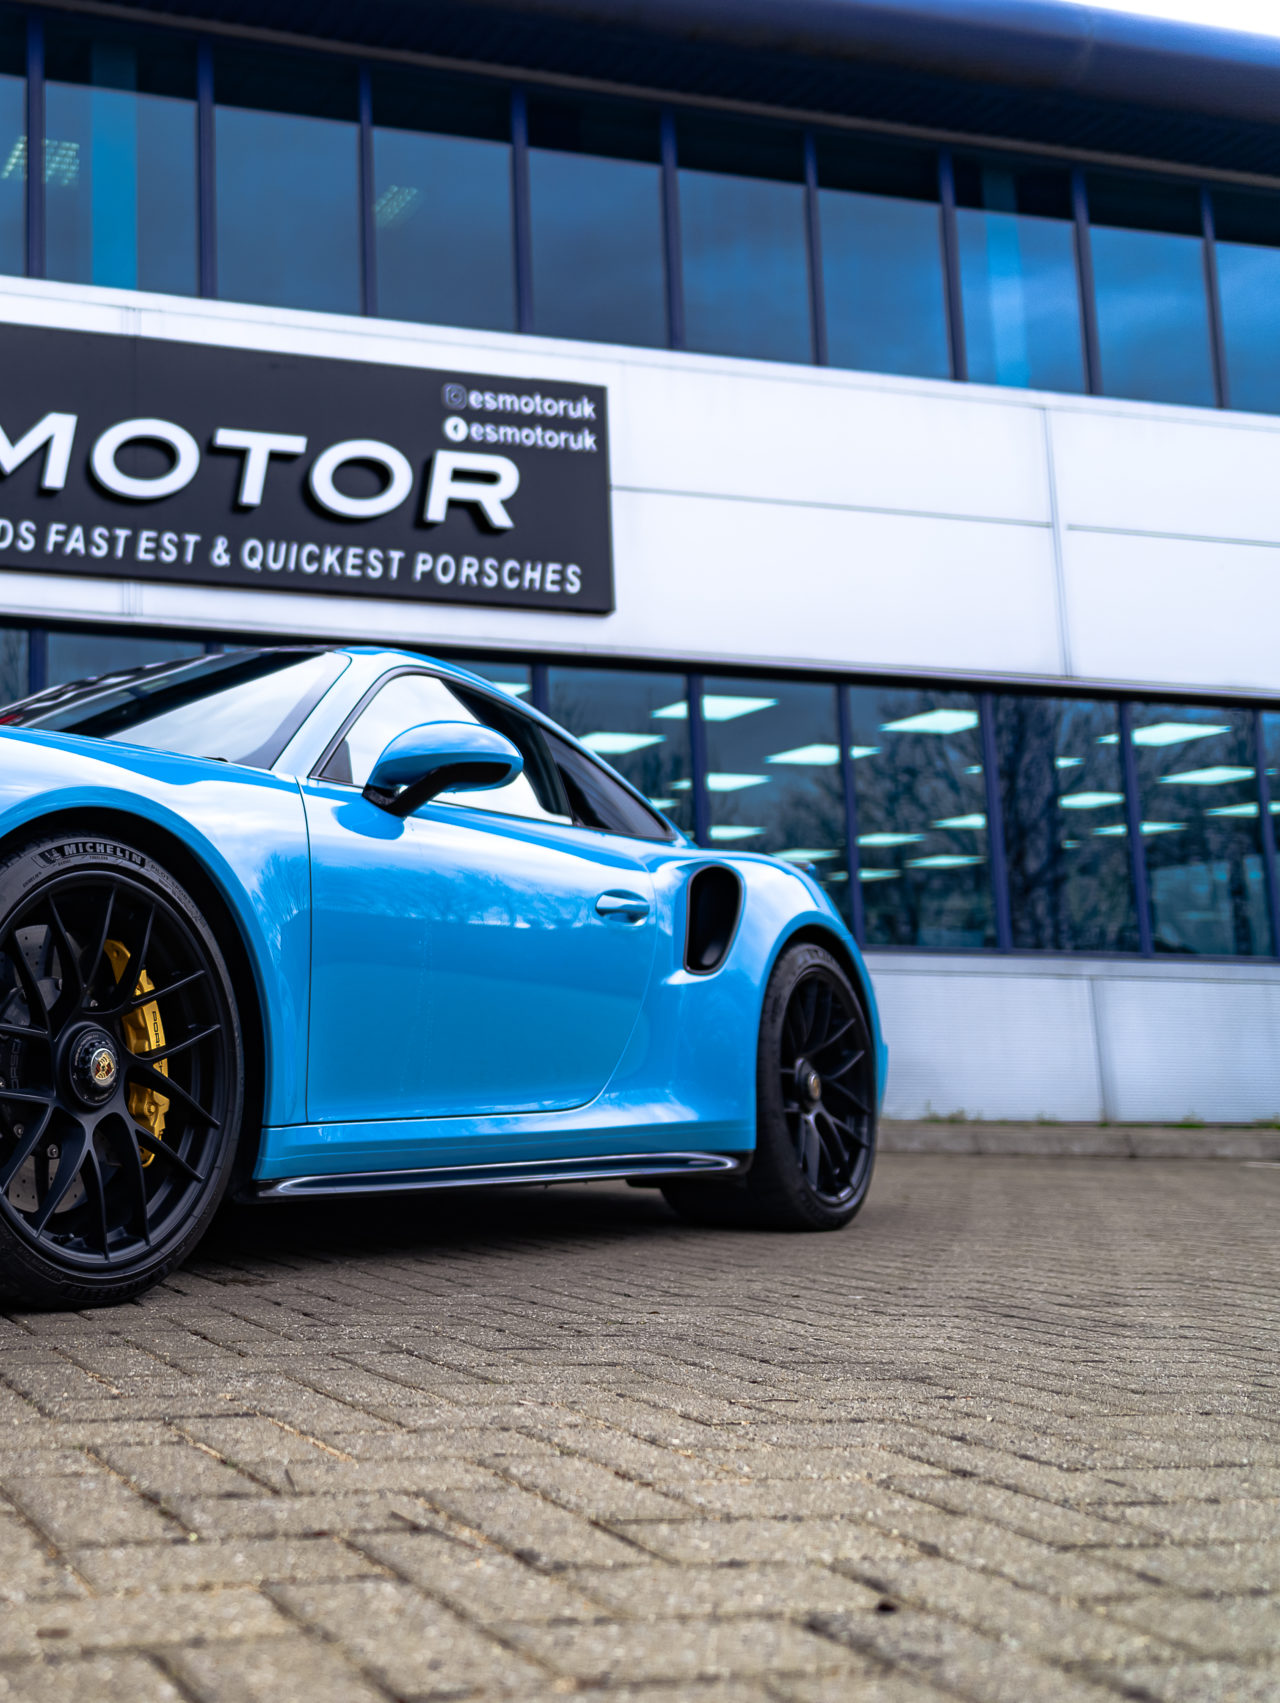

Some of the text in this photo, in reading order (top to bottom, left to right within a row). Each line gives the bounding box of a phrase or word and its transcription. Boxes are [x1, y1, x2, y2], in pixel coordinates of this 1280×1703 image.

[469, 389, 597, 420] esmotoruk
[470, 422, 598, 451] esmotoruk
[46, 523, 201, 564] FASTEST
[211, 537, 230, 567] &
[240, 538, 405, 579] QUICKEST
[413, 552, 584, 594] PORSCHES
[64, 842, 142, 865] MICHELIN
